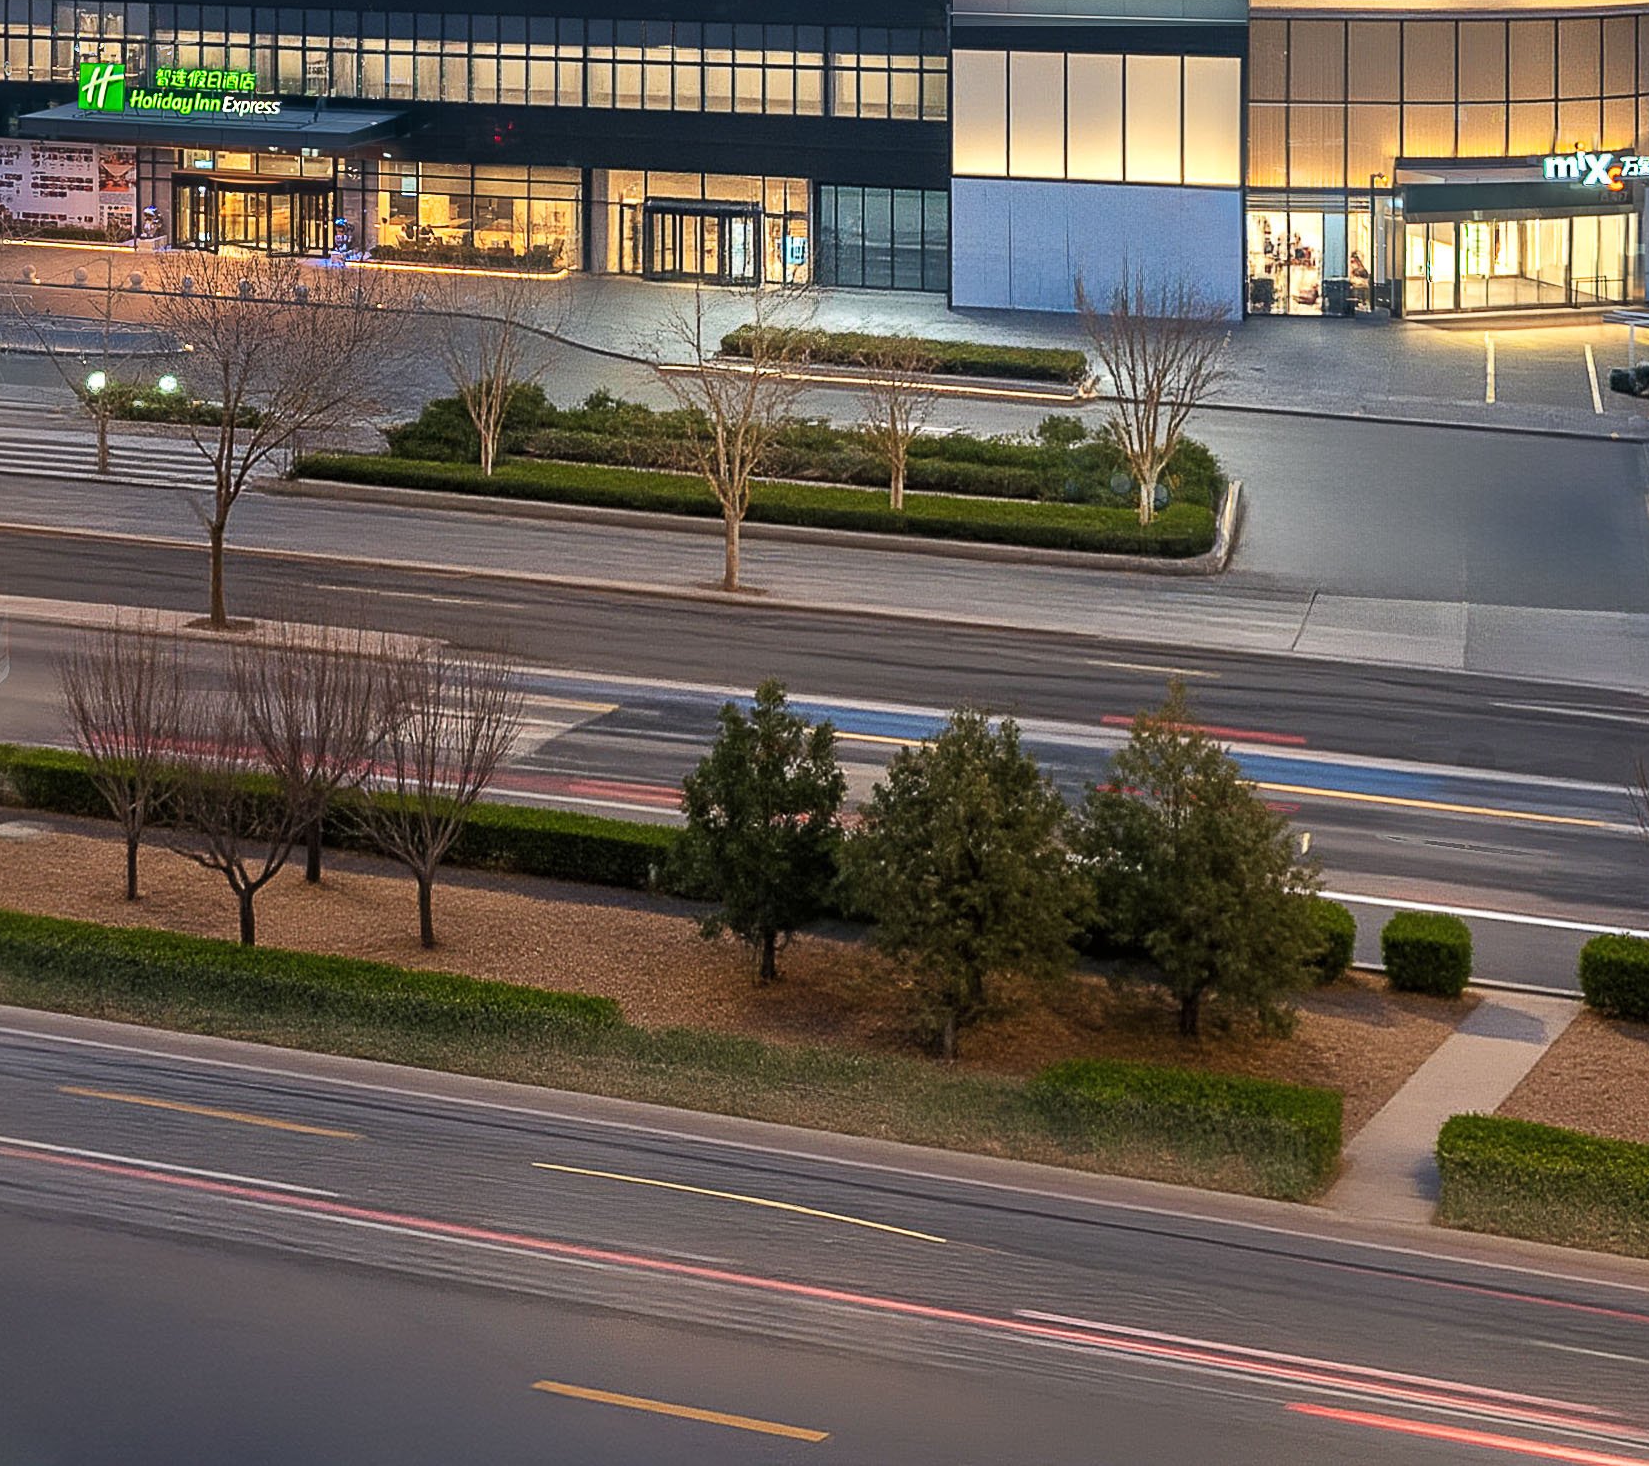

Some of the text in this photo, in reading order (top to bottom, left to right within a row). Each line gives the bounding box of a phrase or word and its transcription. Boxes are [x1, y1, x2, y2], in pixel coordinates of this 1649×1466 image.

[155, 67, 257, 90] 智选假日酒店
[129, 89, 282, 117] Holiday Inn Express
